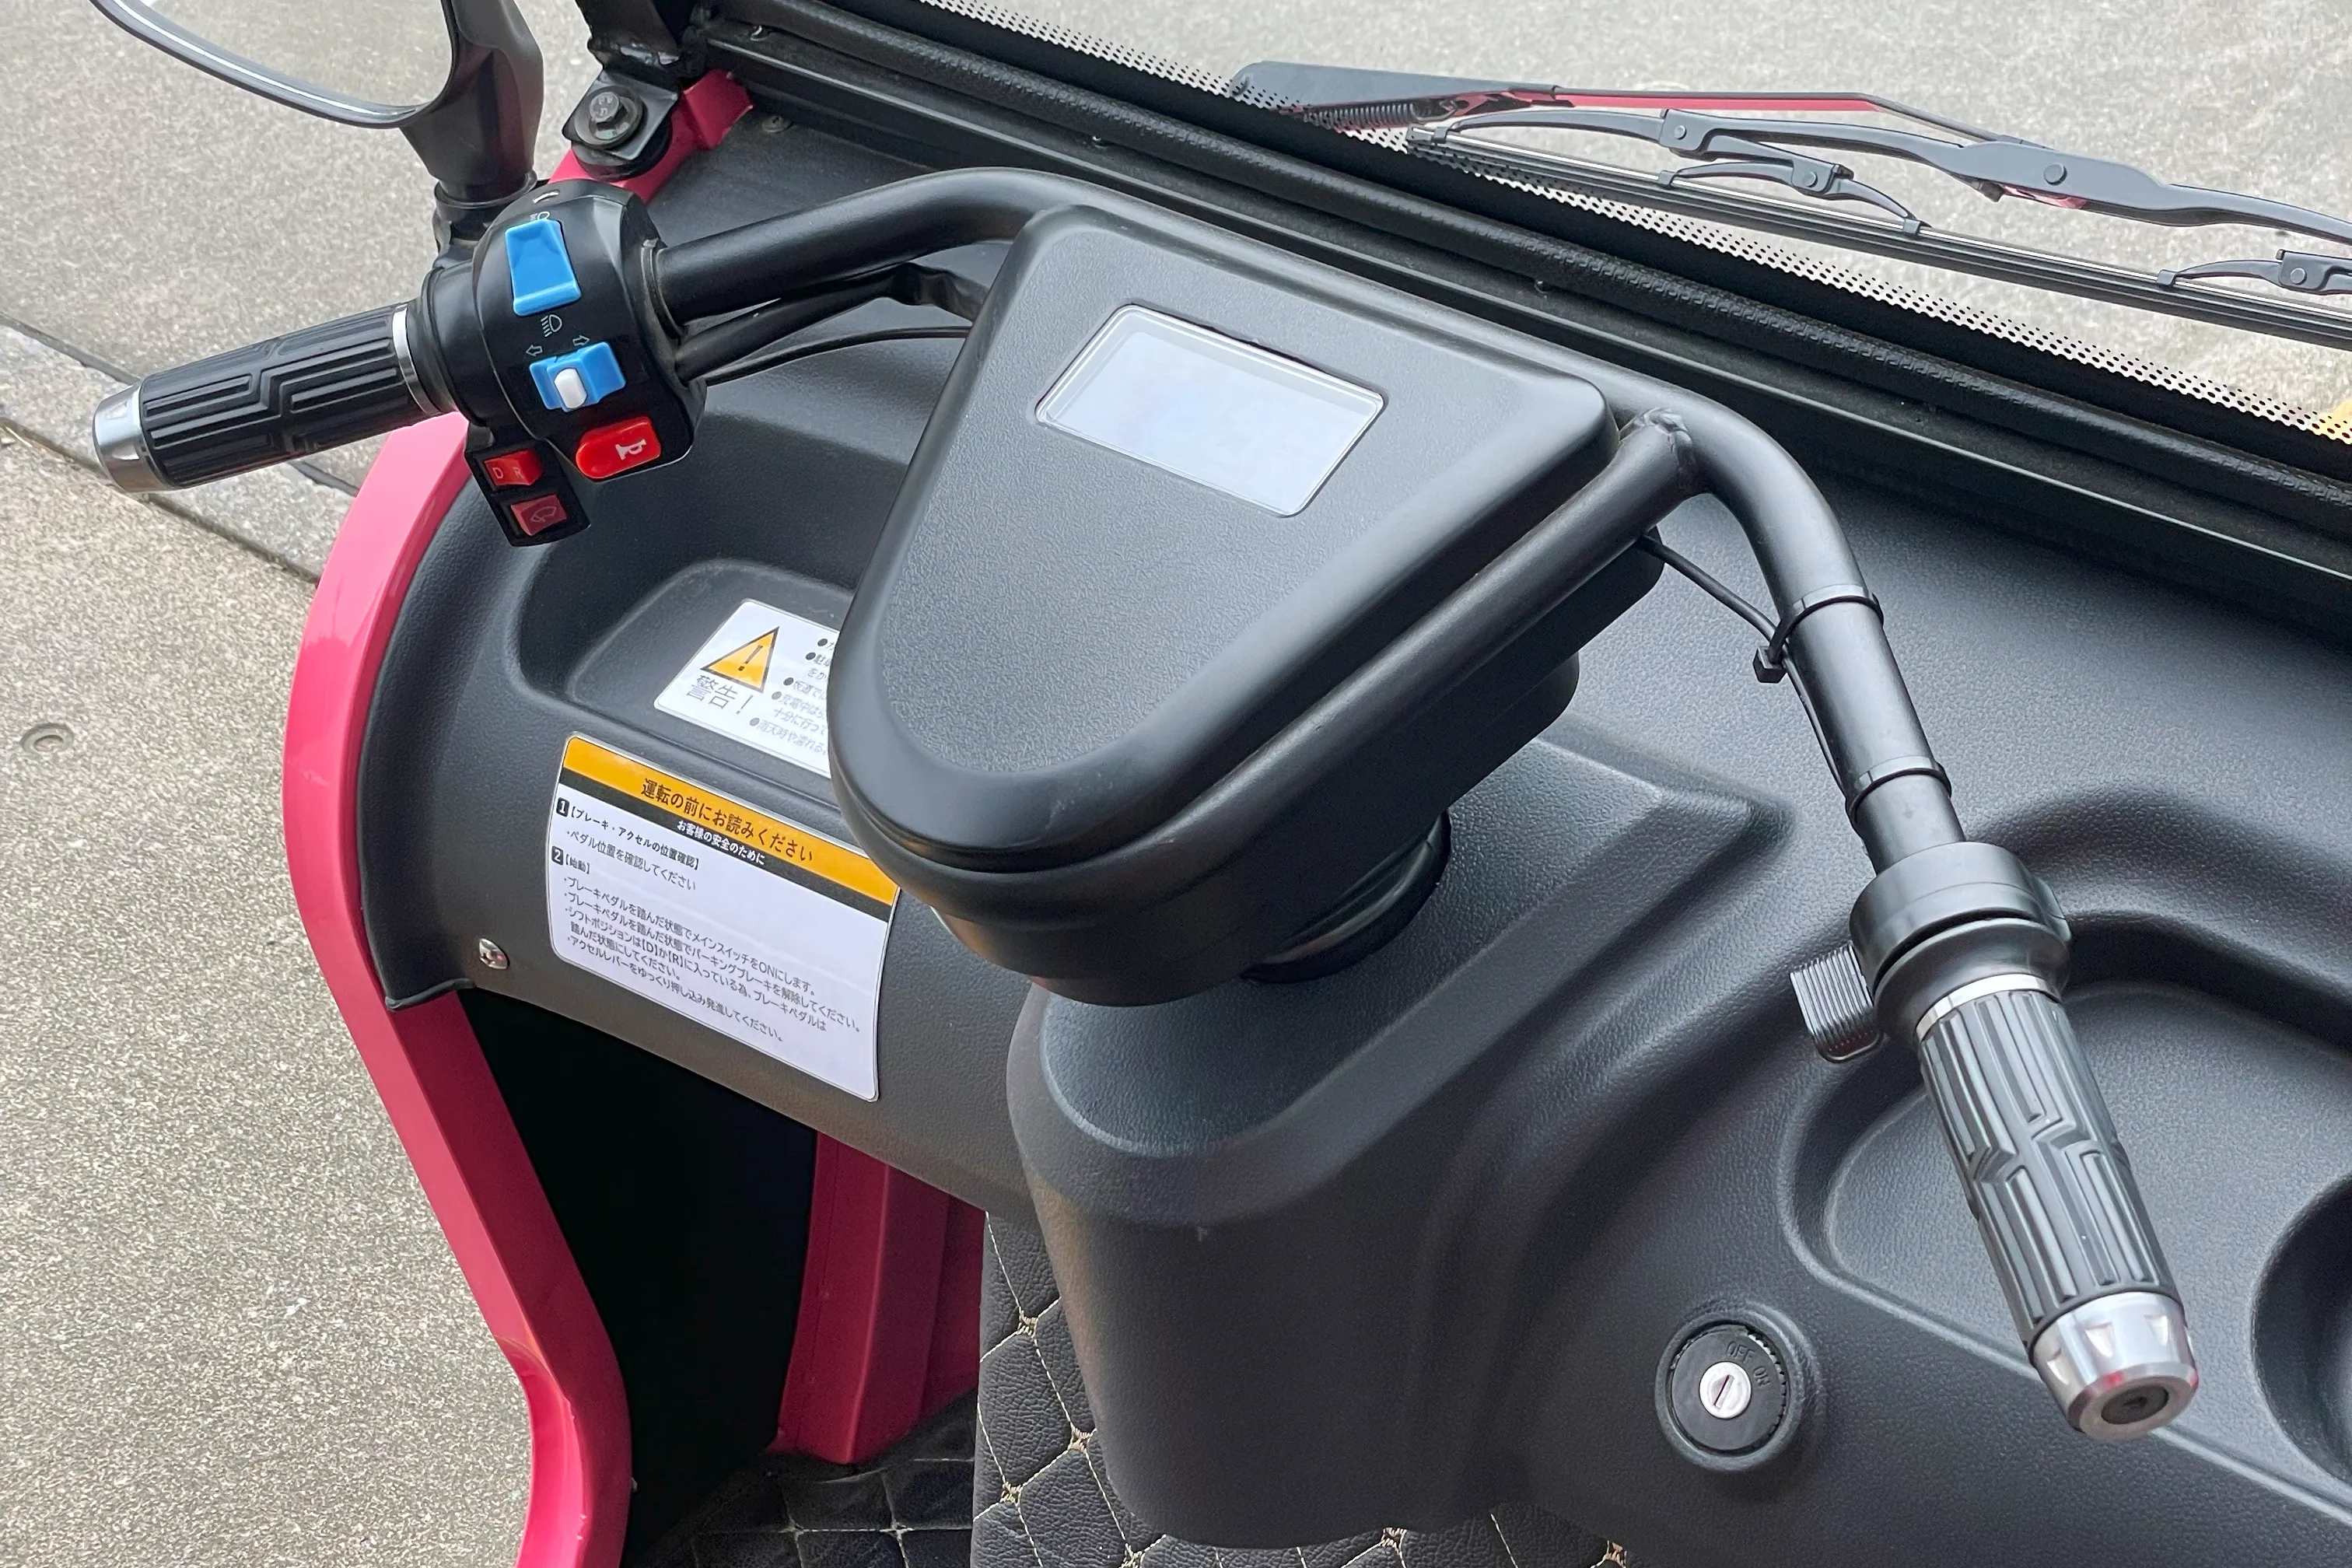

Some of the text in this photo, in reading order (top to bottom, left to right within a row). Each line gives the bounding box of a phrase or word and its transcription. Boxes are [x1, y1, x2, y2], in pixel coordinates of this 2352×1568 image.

[492, 467, 525, 479] D R
[640, 777, 814, 863] 運転の前にお読みください
[676, 820, 766, 865] お客様の安全のために
[1725, 1339, 1755, 1363] OFF
[1753, 1365, 1771, 1388] ON
